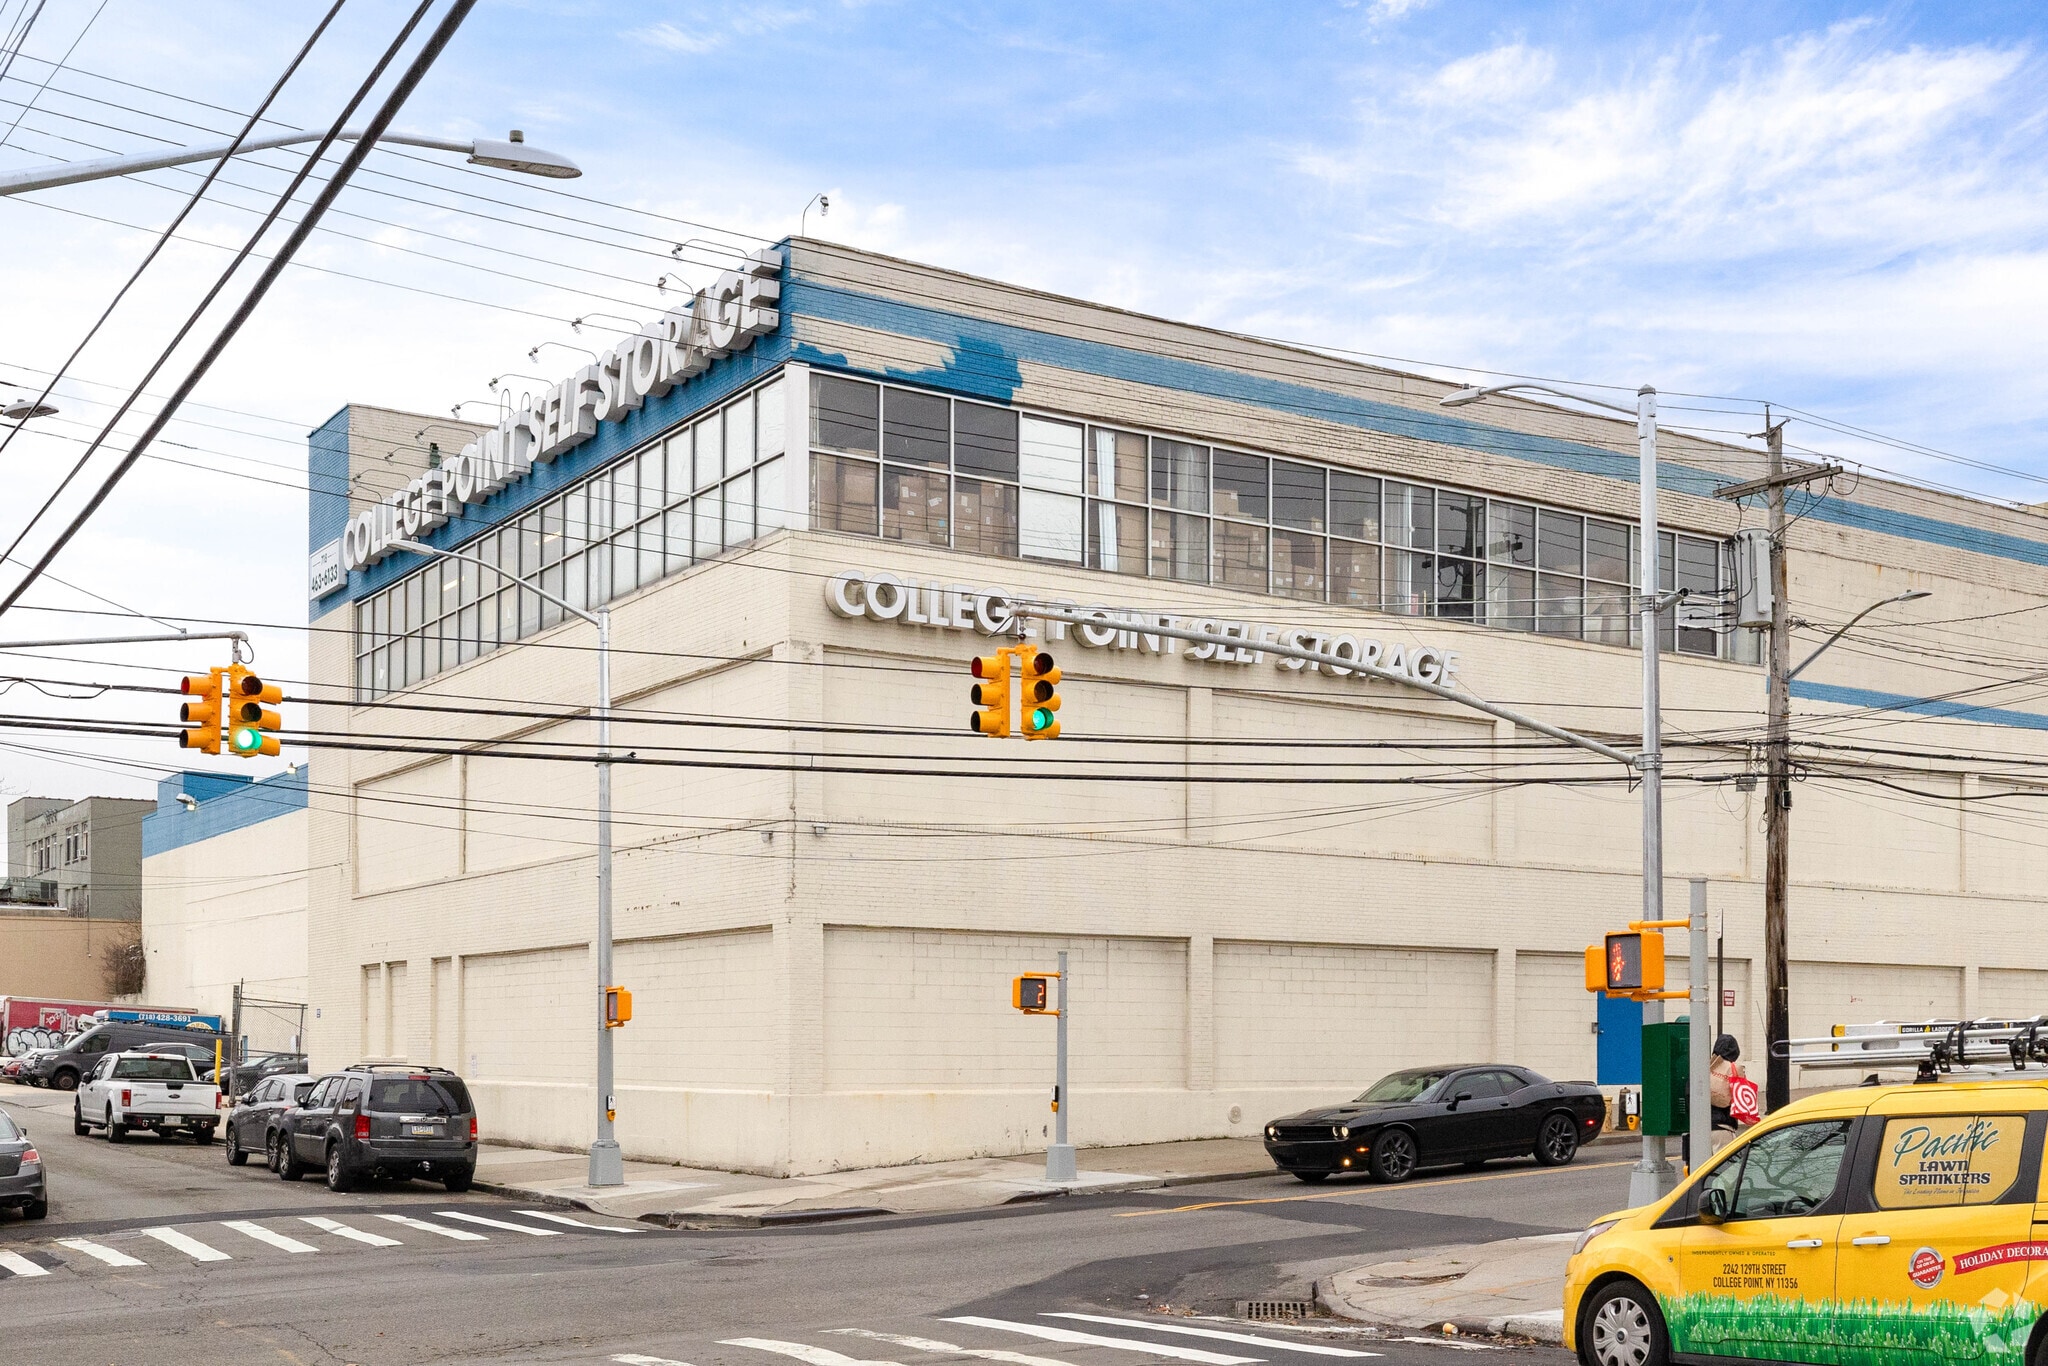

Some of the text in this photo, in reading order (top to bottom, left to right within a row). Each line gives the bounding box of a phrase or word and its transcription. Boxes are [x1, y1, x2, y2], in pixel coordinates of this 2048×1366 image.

[343, 248, 783, 571] COLLEGE POINT SELF STORAGE
[1183, 618, 1279, 665] SELF
[1275, 627, 1461, 688] STORAGE
[156, 1014, 191, 1022] 428-3691
[1893, 1120, 1999, 1167] Pacific
[1898, 1172, 1991, 1185] SPRINKLERS
[1960, 1249, 2004, 1269] HOLIDAY
[1723, 1263, 1787, 1275] 2242 129TH STREET
[1912, 1264, 1941, 1277] GUARANTEE
[1713, 1277, 1798, 1289] COLLEGE POINT, NY 11356
